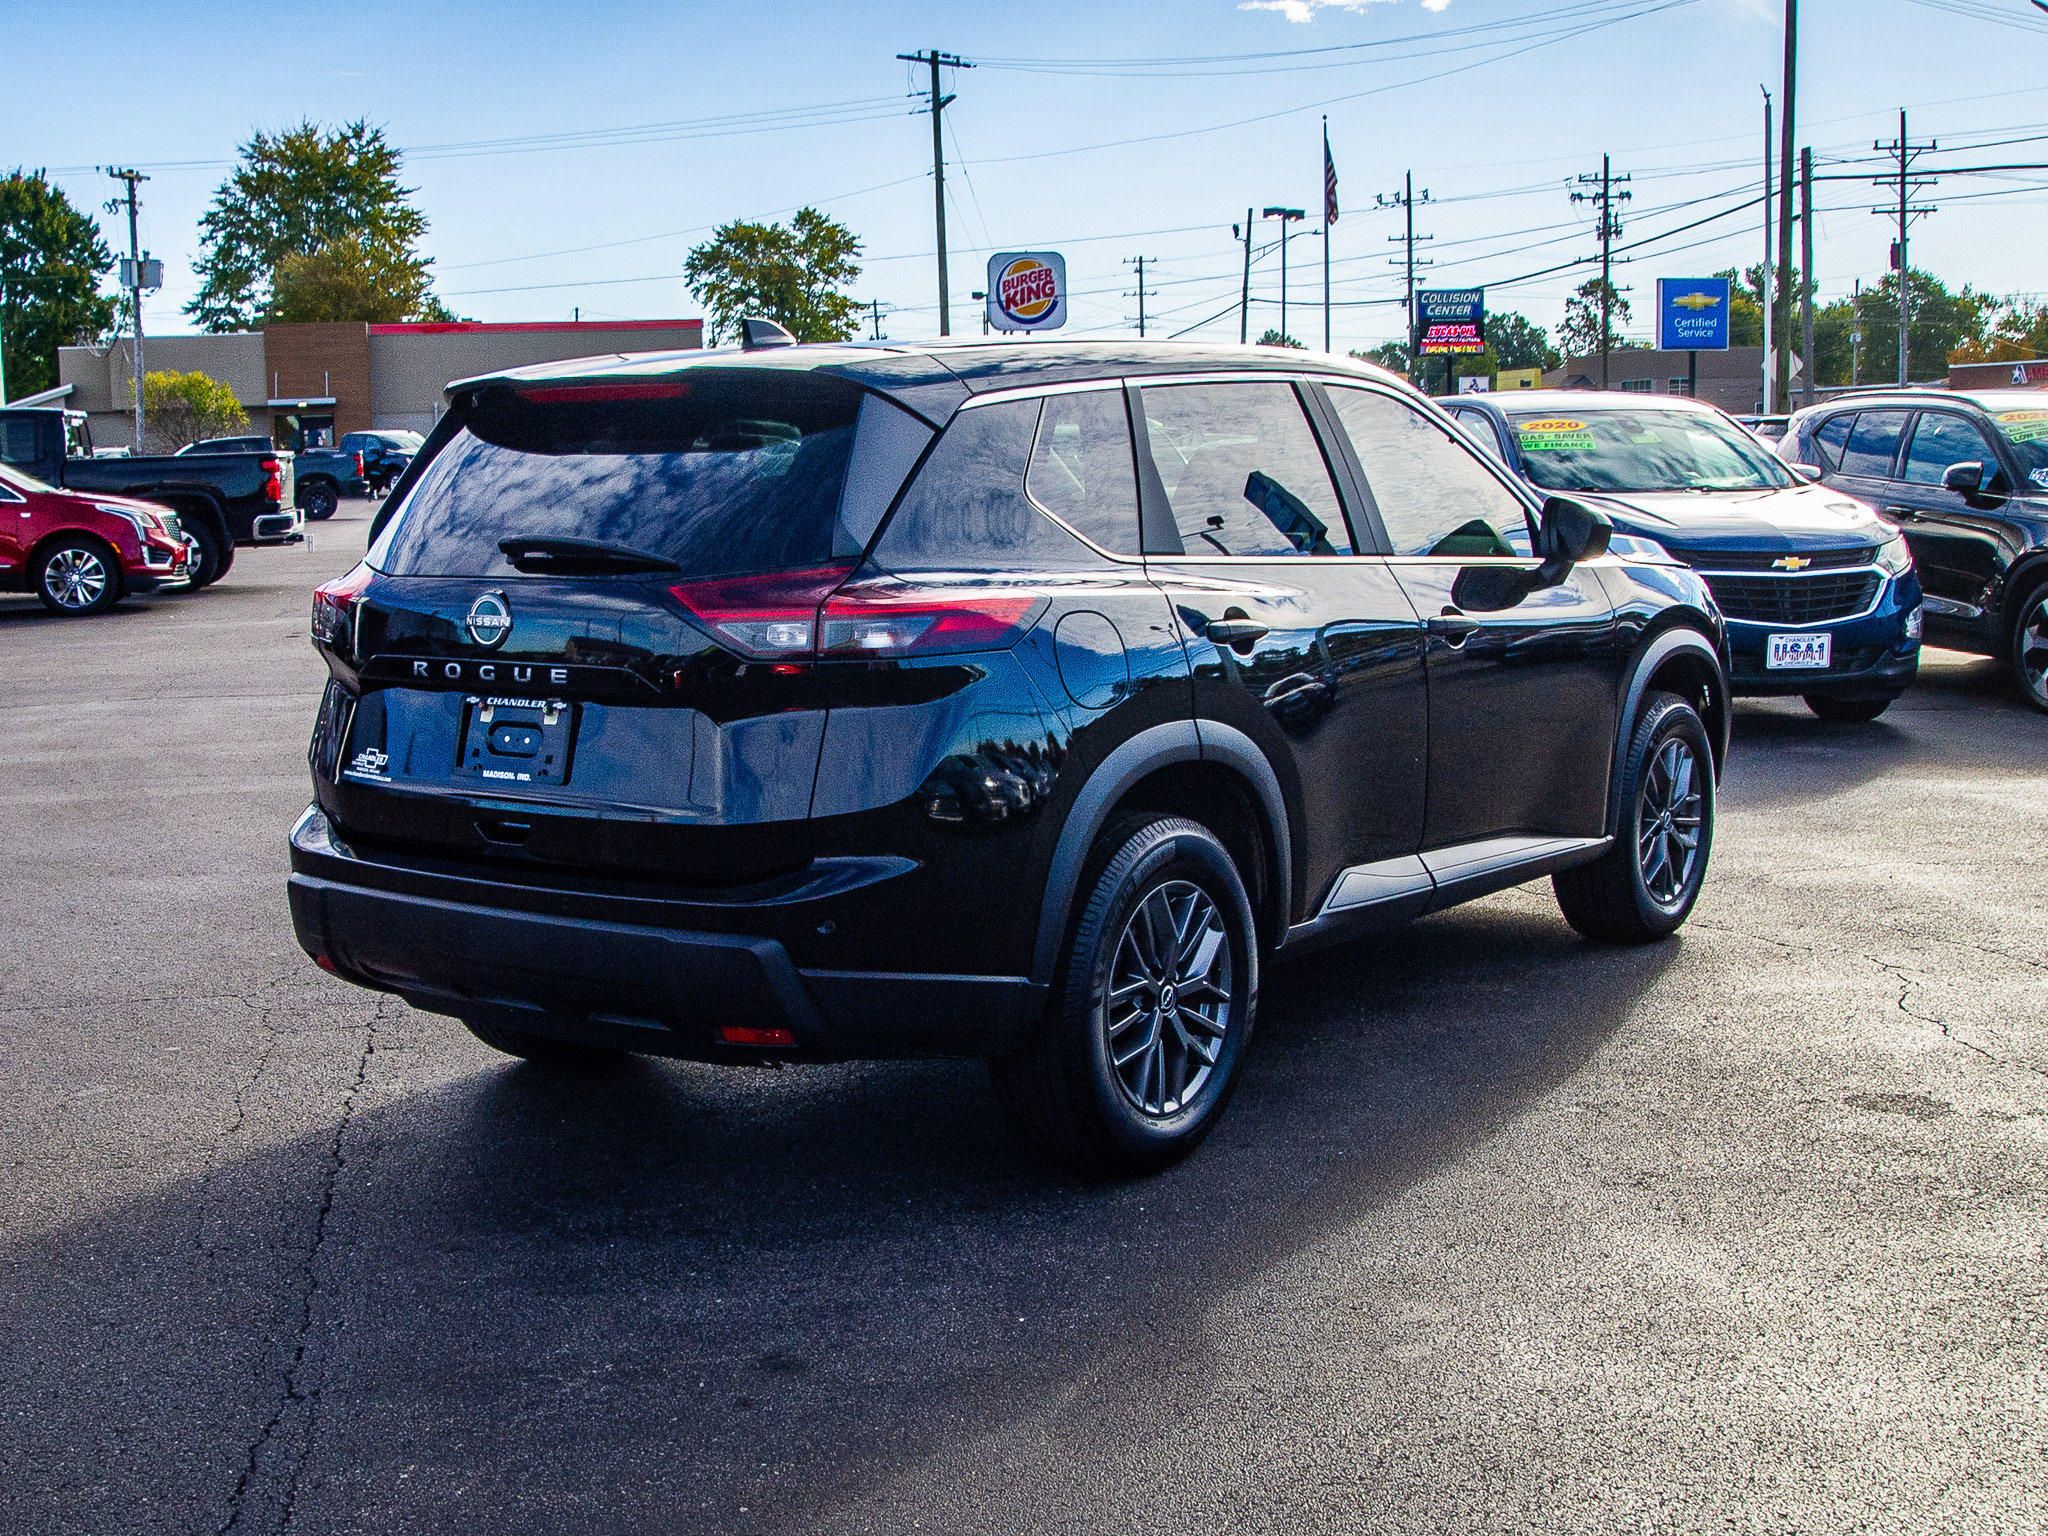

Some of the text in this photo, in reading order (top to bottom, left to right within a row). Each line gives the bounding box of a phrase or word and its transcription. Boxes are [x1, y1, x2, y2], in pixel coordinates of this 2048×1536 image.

[1002, 268, 1053, 294] BURGER
[1004, 280, 1056, 312] KING
[1421, 293, 1481, 304] COLLISION
[1427, 304, 1473, 316] CENTER
[1674, 317, 1717, 328] Certified
[1677, 328, 1714, 338] Service
[1528, 421, 1581, 431] 2020
[1521, 433, 1545, 441] GAS
[1554, 432, 1592, 440] SAVER
[1523, 441, 1594, 449] WE FINANCE
[466, 616, 511, 627] NISSAN
[413, 661, 568, 684] ROGUE
[487, 697, 547, 708] CHANDLER
[516, 772, 532, 782] IND.
